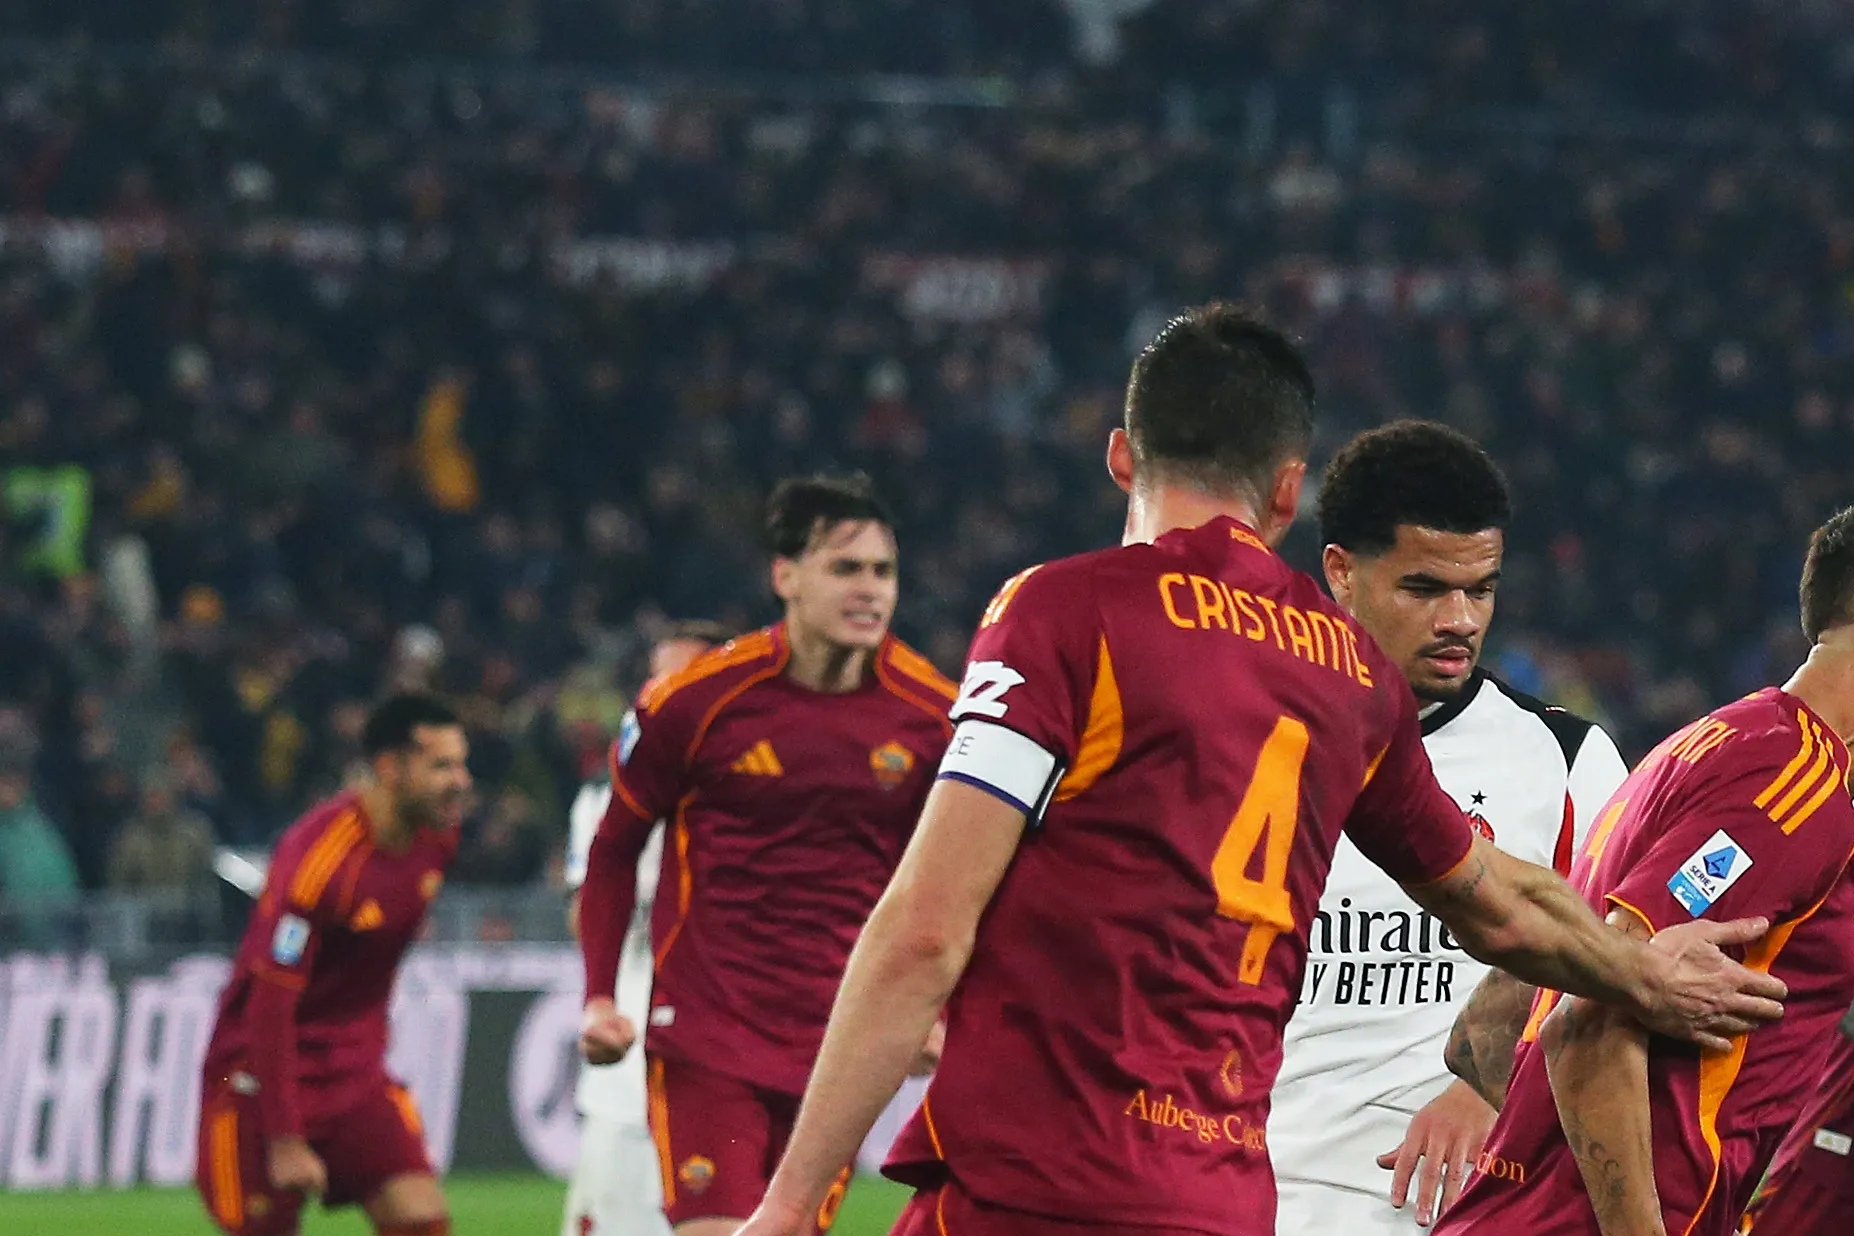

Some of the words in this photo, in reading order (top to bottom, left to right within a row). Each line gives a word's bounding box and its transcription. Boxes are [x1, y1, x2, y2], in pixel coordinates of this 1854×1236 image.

[1158, 572, 1374, 688] CRISTANTE
[1211, 715, 1310, 986] 4
[1334, 961, 1454, 1006] BETTER
